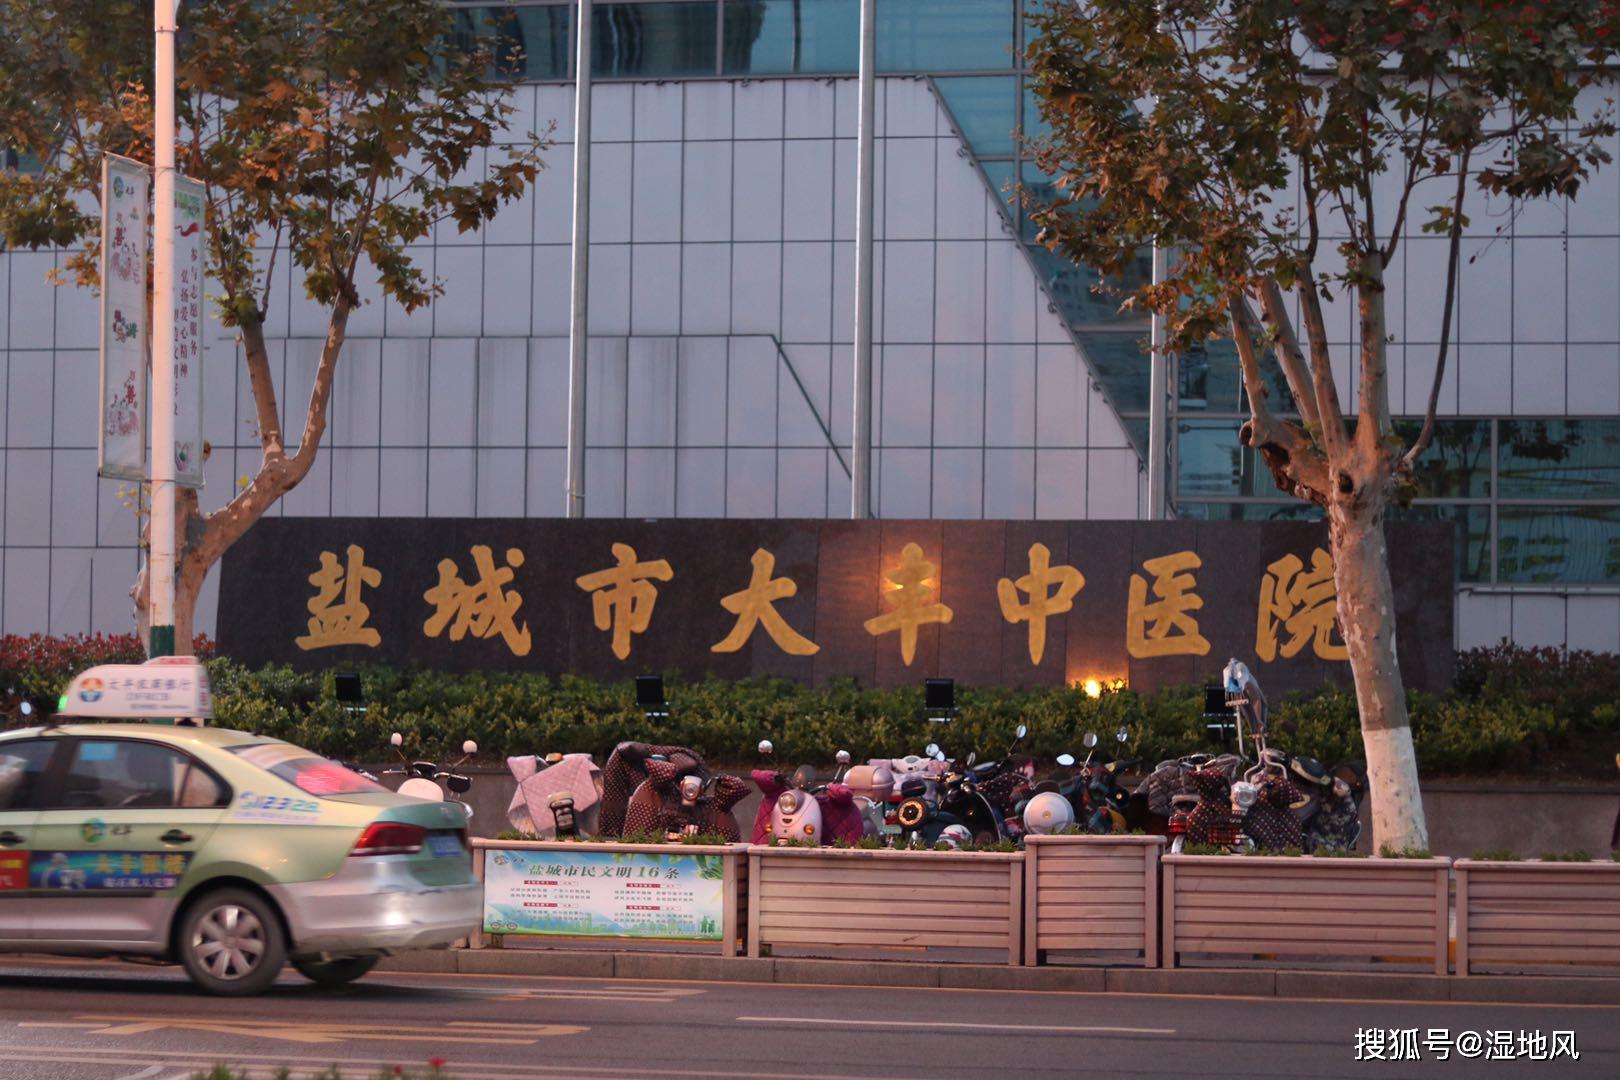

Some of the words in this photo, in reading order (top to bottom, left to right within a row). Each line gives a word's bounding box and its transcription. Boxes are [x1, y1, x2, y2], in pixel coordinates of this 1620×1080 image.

[180, 268, 189, 379] 弘扬爱心精神
[189, 247, 198, 356] 参与志愿服务
[295, 542, 1352, 667] 盐城市大丰中医院
